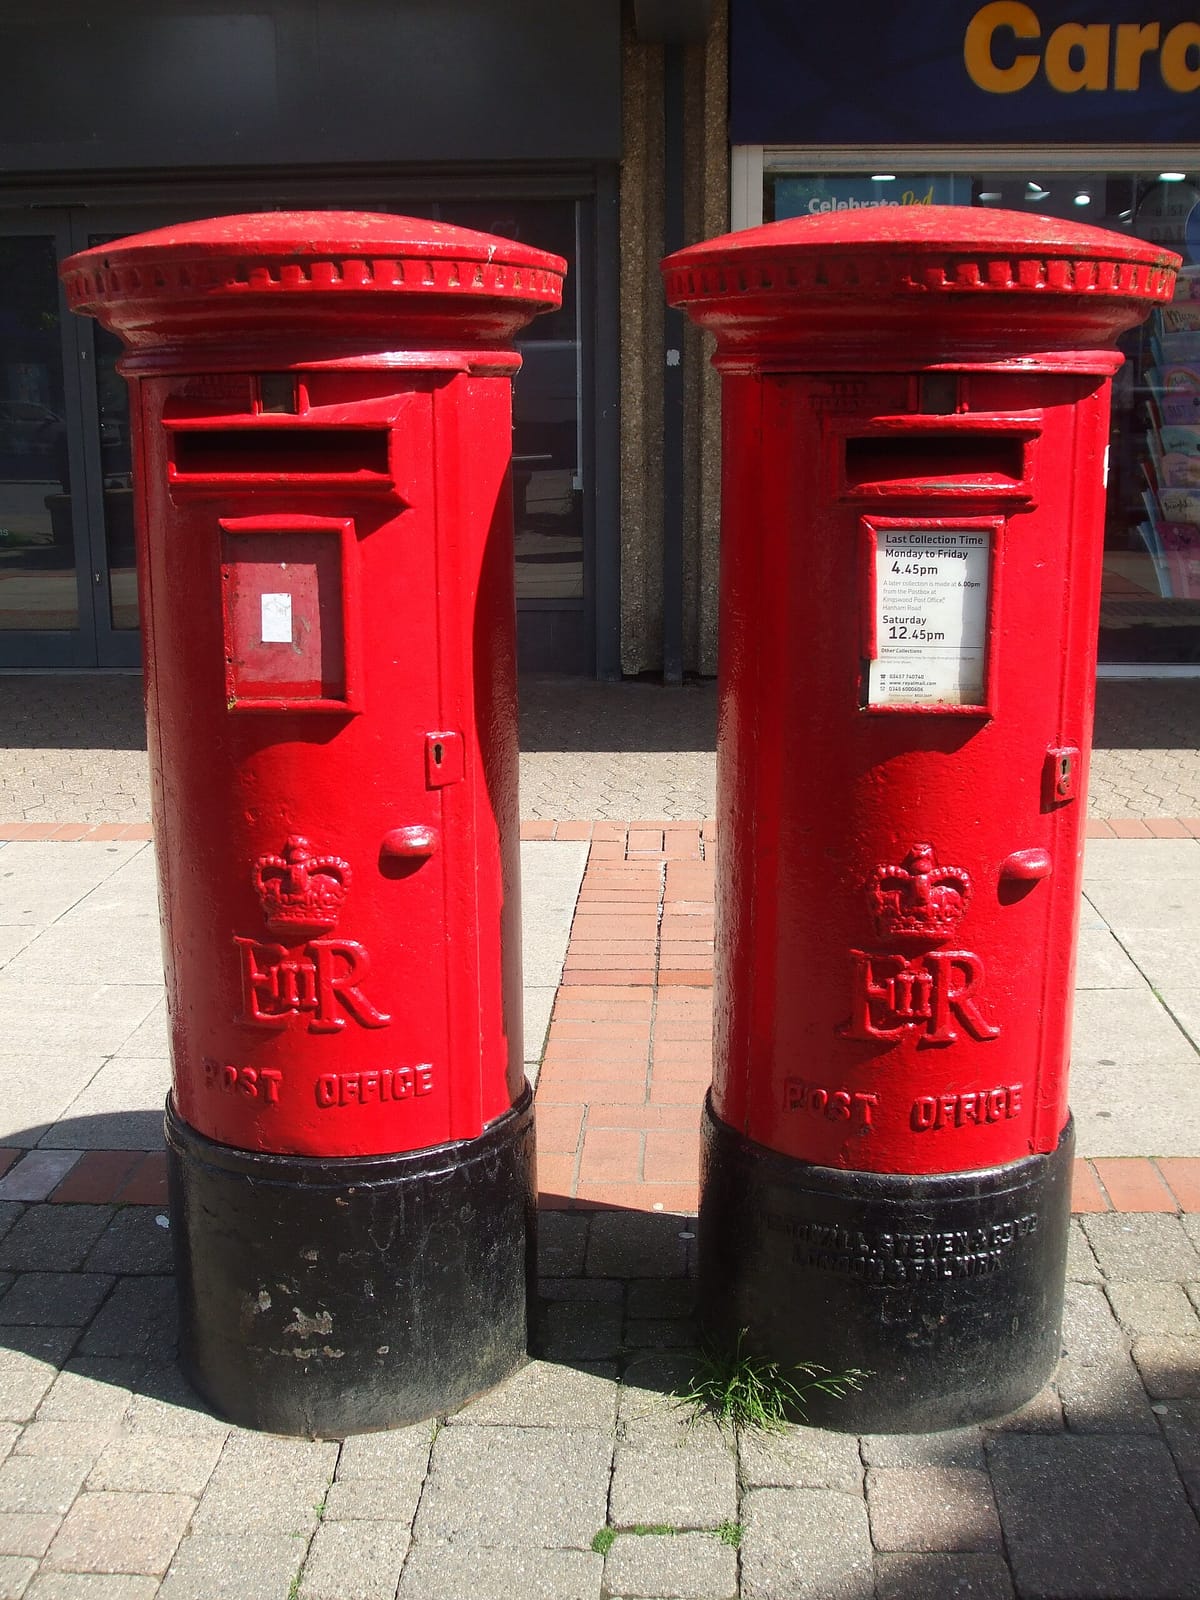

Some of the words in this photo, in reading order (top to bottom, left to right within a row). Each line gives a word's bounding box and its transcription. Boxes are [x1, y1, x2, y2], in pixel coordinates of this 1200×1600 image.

[885, 534, 907, 544] Last
[909, 534, 957, 545] Collection
[959, 535, 984, 545] Time
[885, 549, 923, 560] Monday
[925, 550, 936, 559] to
[937, 549, 969, 561] Friday
[891, 560, 938, 577] 4.45pm
[957, 581, 981, 589] 6.00pm
[882, 614, 927, 626] Saturday
[888, 625, 945, 642] 12.45pm
[202, 1057, 283, 1107] POST
[314, 1061, 434, 1108] OFFICE
[783, 1077, 880, 1137] POST
[909, 1083, 1024, 1133] OFFICE
